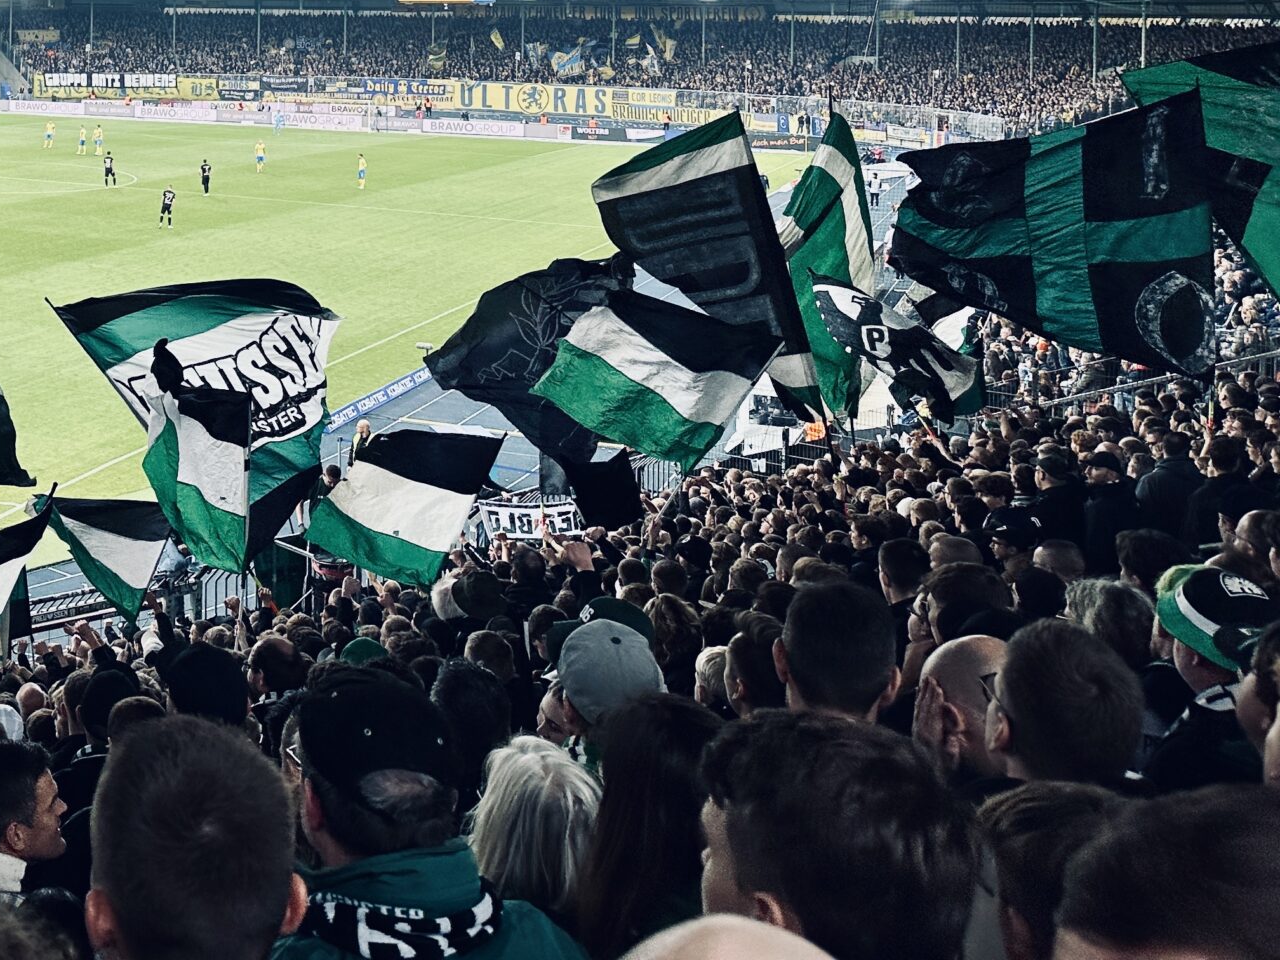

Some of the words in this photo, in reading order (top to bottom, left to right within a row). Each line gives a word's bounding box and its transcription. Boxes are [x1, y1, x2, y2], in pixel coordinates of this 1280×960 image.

[365, 80, 395, 93] Daily
[409, 82, 445, 94] Terror
[140, 107, 210, 119] BRAWOGROUP
[283, 113, 356, 127] RAWOGROUP
[611, 104, 711, 125] BRAUNSCWEIGER
[430, 120, 516, 136] BRAWOGROUP
[576, 127, 610, 136] WOLTERS
[356, 390, 387, 413] KOSATEC
[386, 376, 414, 398] KOSATEC
